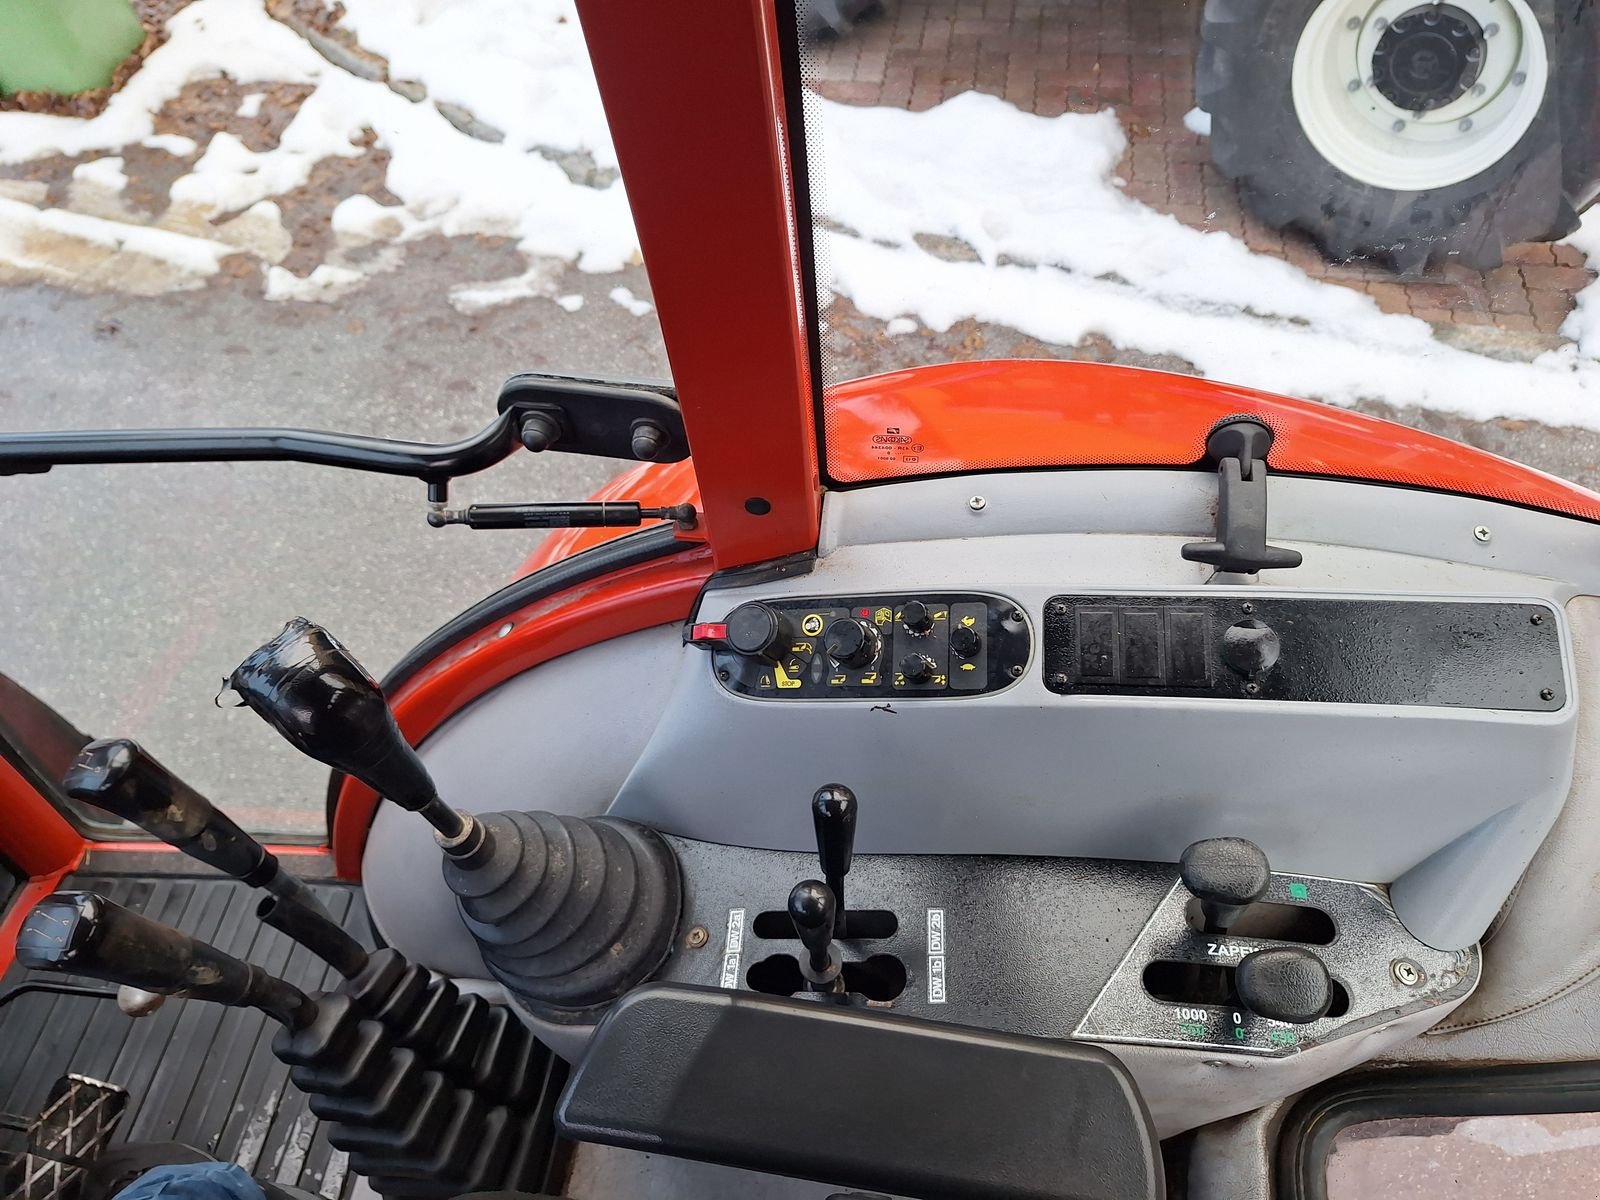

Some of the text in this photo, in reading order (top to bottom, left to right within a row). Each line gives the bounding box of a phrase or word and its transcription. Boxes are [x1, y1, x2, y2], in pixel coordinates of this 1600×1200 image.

[729, 913, 741, 949] DW 2a
[931, 913, 941, 951] DW 2b
[726, 958, 737, 972] 1a
[931, 960, 943, 998] DW 1b
[1174, 1007, 1208, 1021] 1000
[1232, 1012, 1242, 1025] 0
